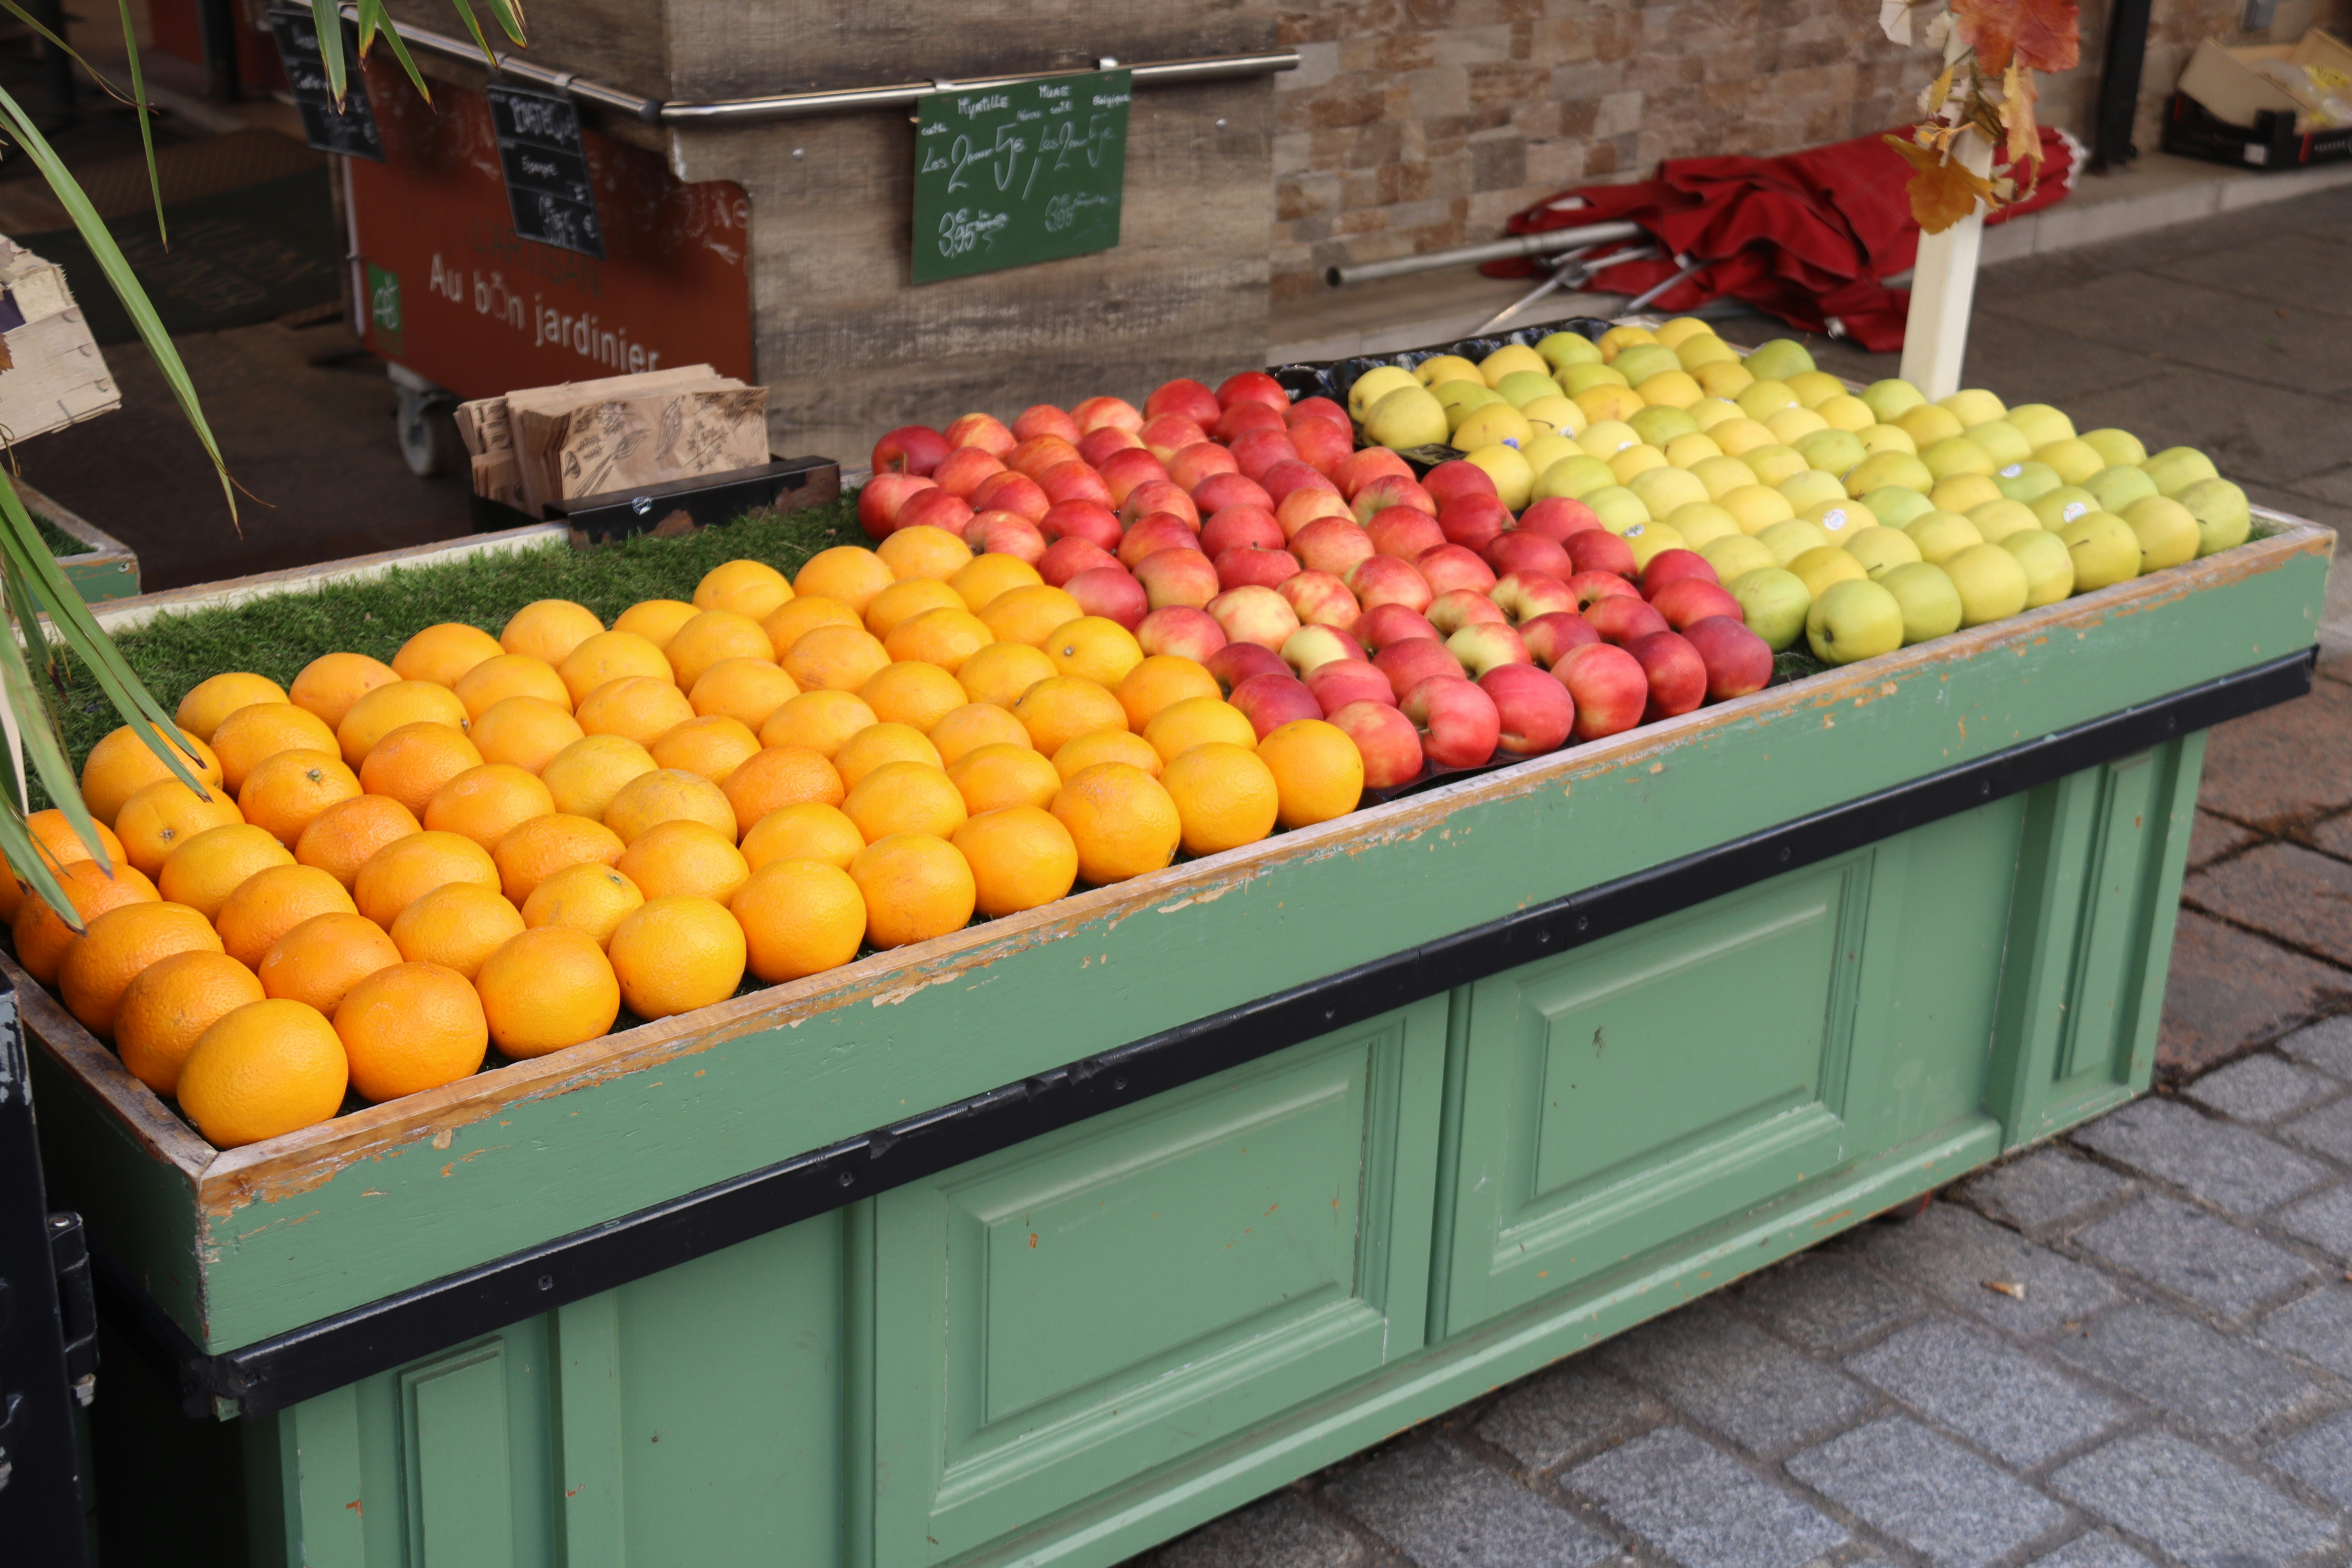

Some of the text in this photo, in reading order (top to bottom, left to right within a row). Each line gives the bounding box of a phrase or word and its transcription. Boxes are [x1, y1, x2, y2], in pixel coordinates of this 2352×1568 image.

[921, 146, 947, 173] Les
[947, 134, 973, 194] 2
[967, 146, 993, 166] pour
[1054, 121, 1075, 171] 2
[430, 252, 463, 303] Au
[535, 292, 661, 374] jardinier
